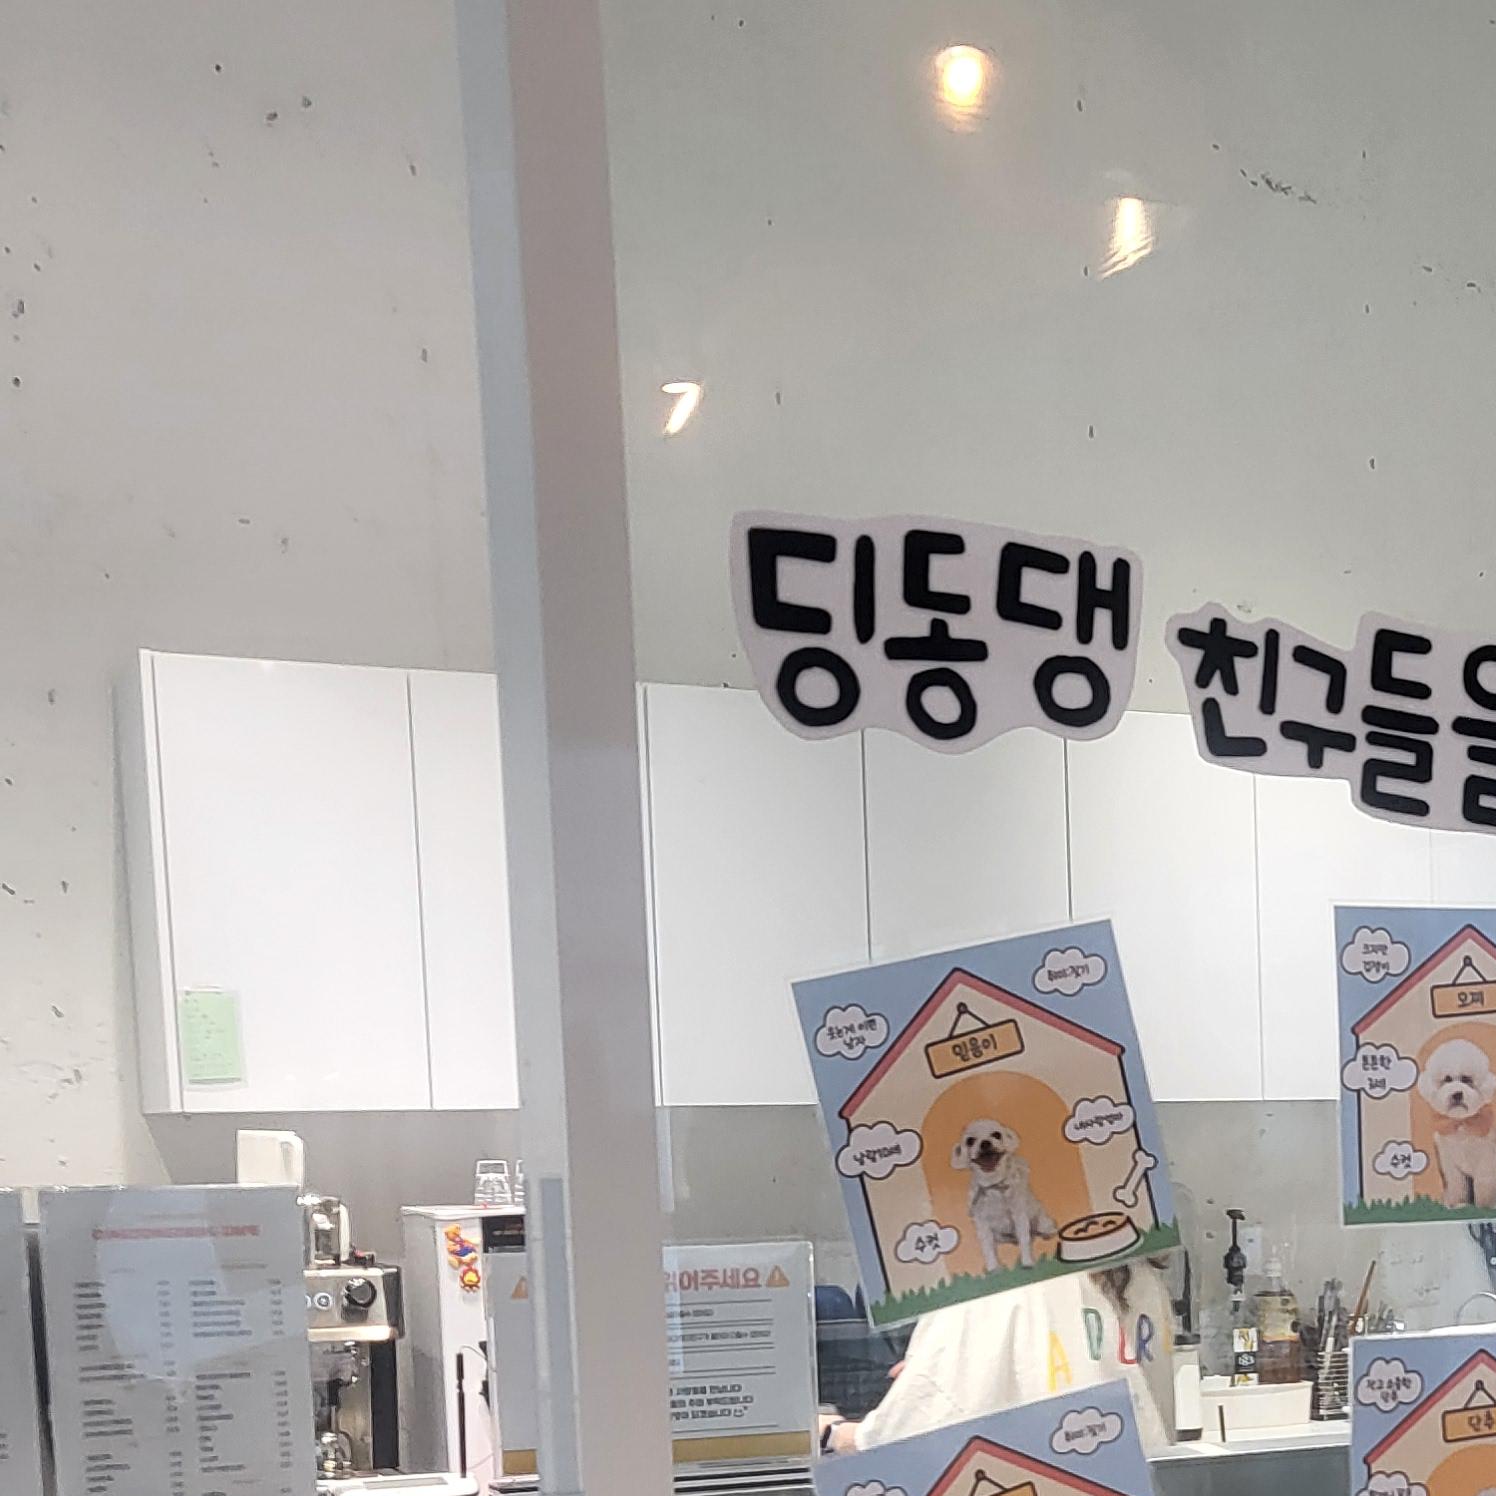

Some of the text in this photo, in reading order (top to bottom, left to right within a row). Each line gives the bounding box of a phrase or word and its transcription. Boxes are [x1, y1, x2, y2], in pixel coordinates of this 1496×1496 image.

[747, 527, 1130, 740] 딩동댕
[1391, 1154, 1412, 1168] 수컷
[914, 1231, 941, 1253] 수컷
[1467, 1411, 1495, 1433] 단추
